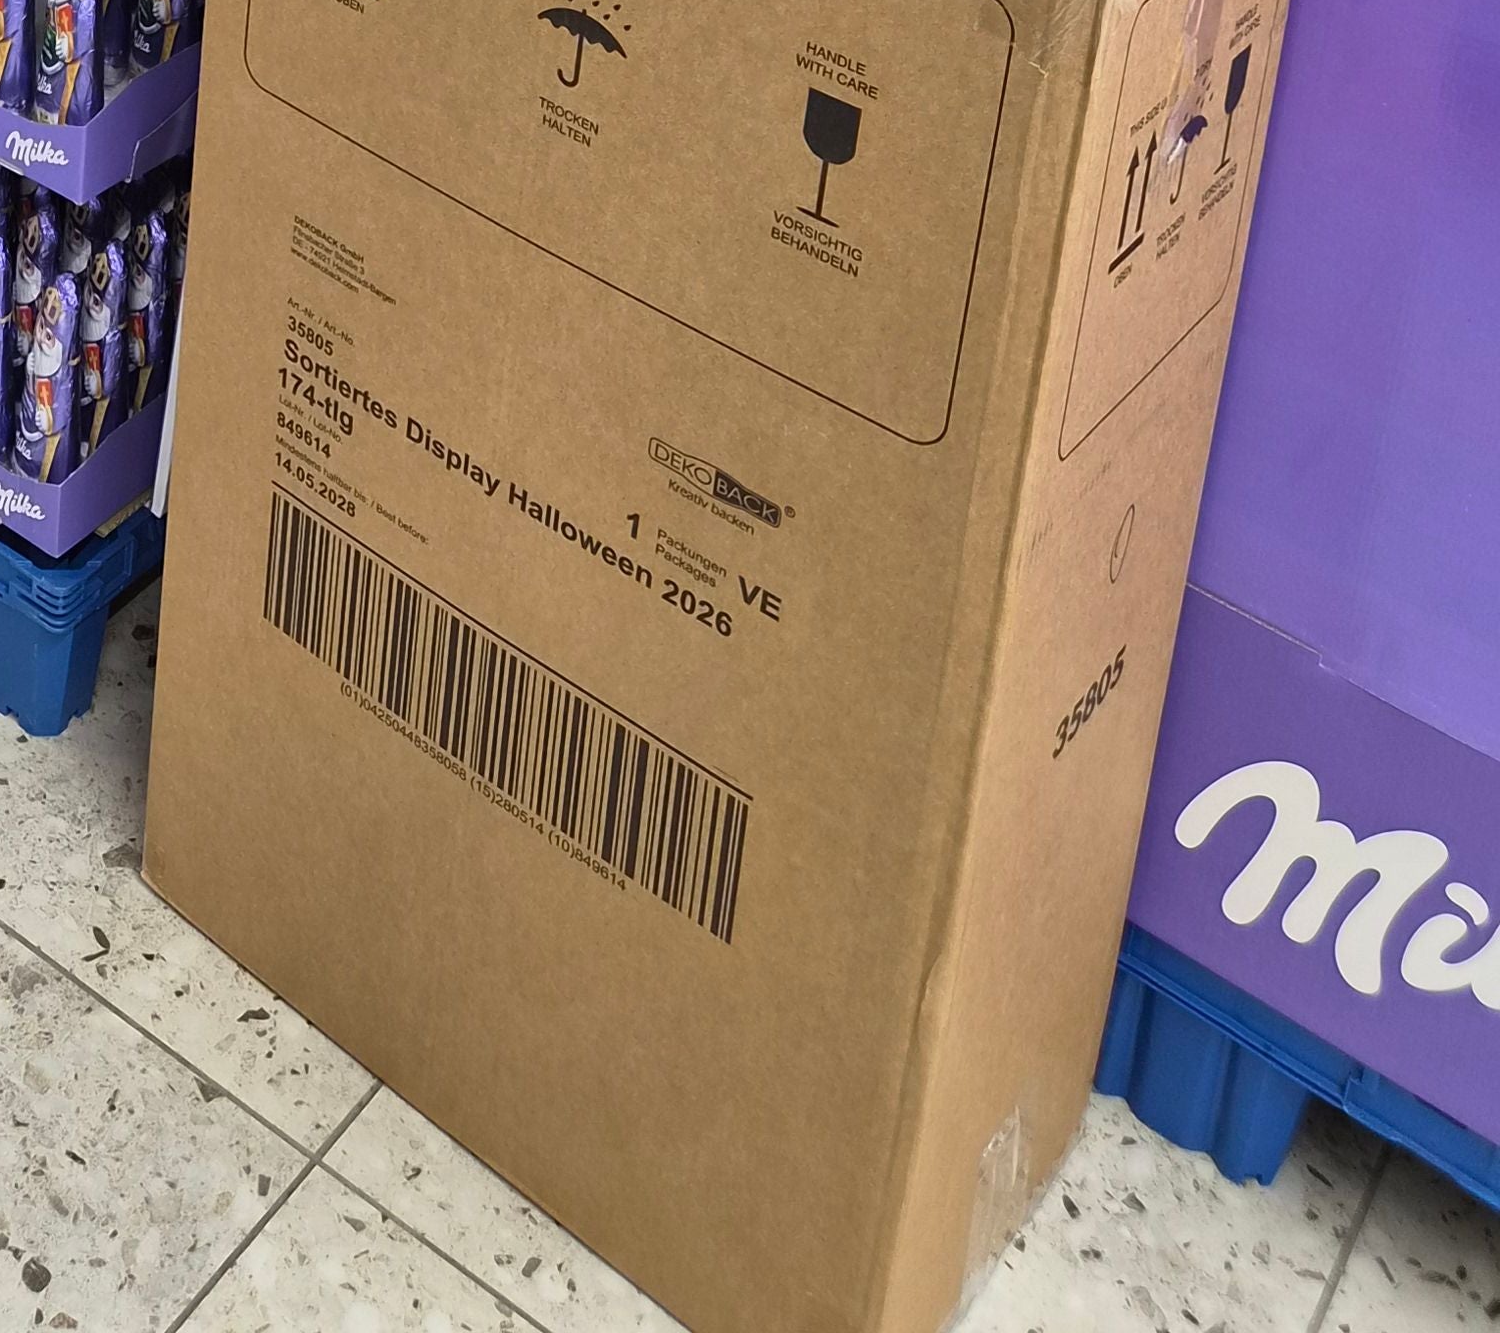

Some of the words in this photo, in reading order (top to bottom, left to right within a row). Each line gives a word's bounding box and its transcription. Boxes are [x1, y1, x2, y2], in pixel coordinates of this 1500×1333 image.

[796, 53, 834, 80] WITH
[836, 72, 879, 100] CARE
[806, 41, 866, 77] HANDLE
[539, 96, 599, 135] TROCKEN
[542, 114, 591, 148] HALTEN
[5, 130, 69, 167] Milka
[294, 215, 338, 248] DEKOBACK
[771, 227, 859, 277] BEHANDELN
[773, 210, 863, 262] VORSICHTIG
[287, 296, 318, 321] Art.-Nr.
[324, 320, 355, 347] Art.-No.
[287, 315, 334, 357] 35805
[278, 367, 354, 436] 174-tlg
[277, 411, 332, 459] 849614
[275, 451, 357, 519] 14.05.2028
[275, 434, 322, 473] Mindestens
[323, 465, 352, 492] haltbar
[376, 502, 396, 526] Best
[398, 517, 429, 546] before:
[284, 338, 398, 430] Sortiertes
[405, 416, 501, 497] Display
[508, 483, 653, 590] Halloween
[661, 579, 733, 637] 2026
[654, 443, 776, 524] DEKOBACK
[668, 478, 708, 509] Kreativ
[711, 501, 755, 536] backen
[626, 513, 641, 540] 1
[655, 543, 717, 588] Packages
[657, 528, 727, 578] Packungen
[738, 575, 782, 622] VE
[1052, 643, 1127, 759] 35805
[340, 681, 467, 781] (01)04250448358058
[470, 775, 544, 835] (15)280514
[548, 830, 627, 891] (10)849614
[1174, 760, 1500, 1010] Mi
